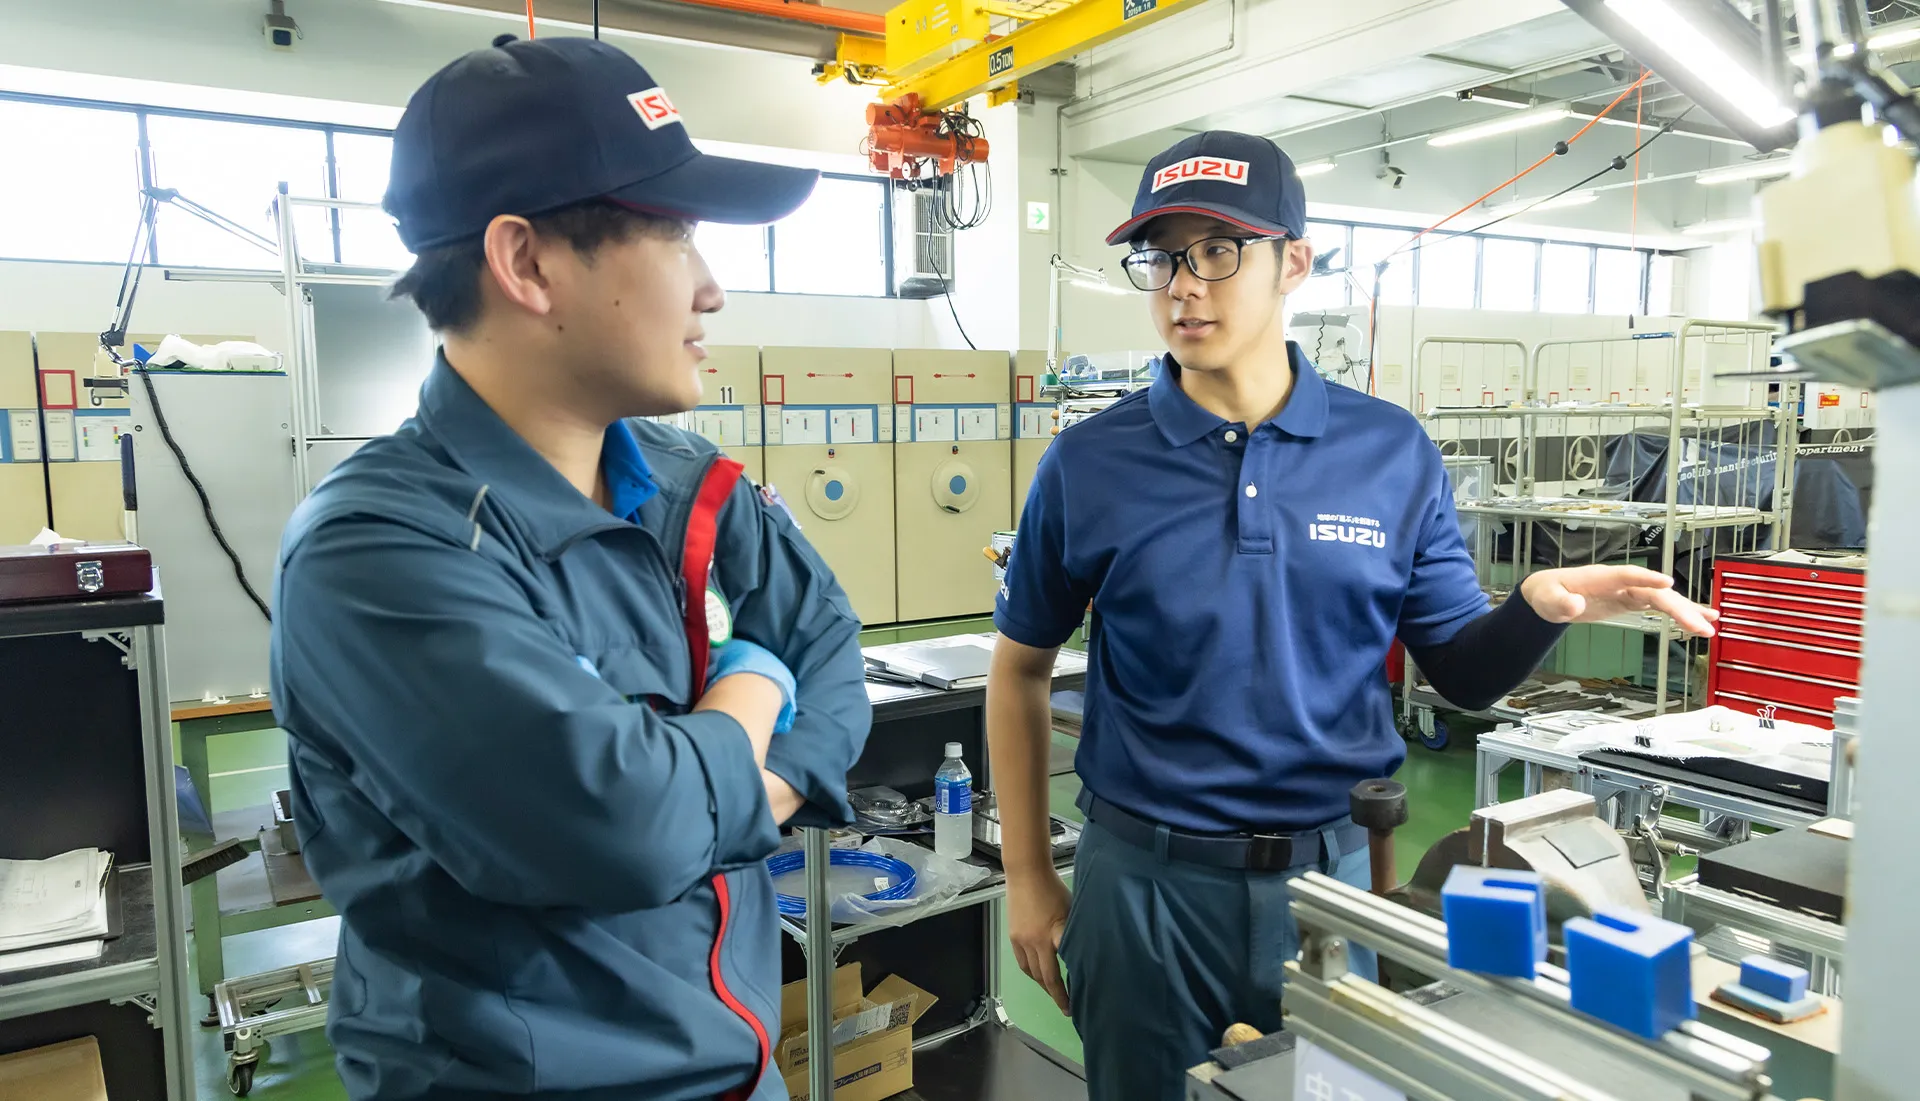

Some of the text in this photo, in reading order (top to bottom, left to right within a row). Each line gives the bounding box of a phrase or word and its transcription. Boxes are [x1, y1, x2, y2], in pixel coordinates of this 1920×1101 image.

[1156, 160, 1244, 188] ISUZU
[720, 386, 732, 404] 11
[1309, 523, 1386, 549] ISUZU
